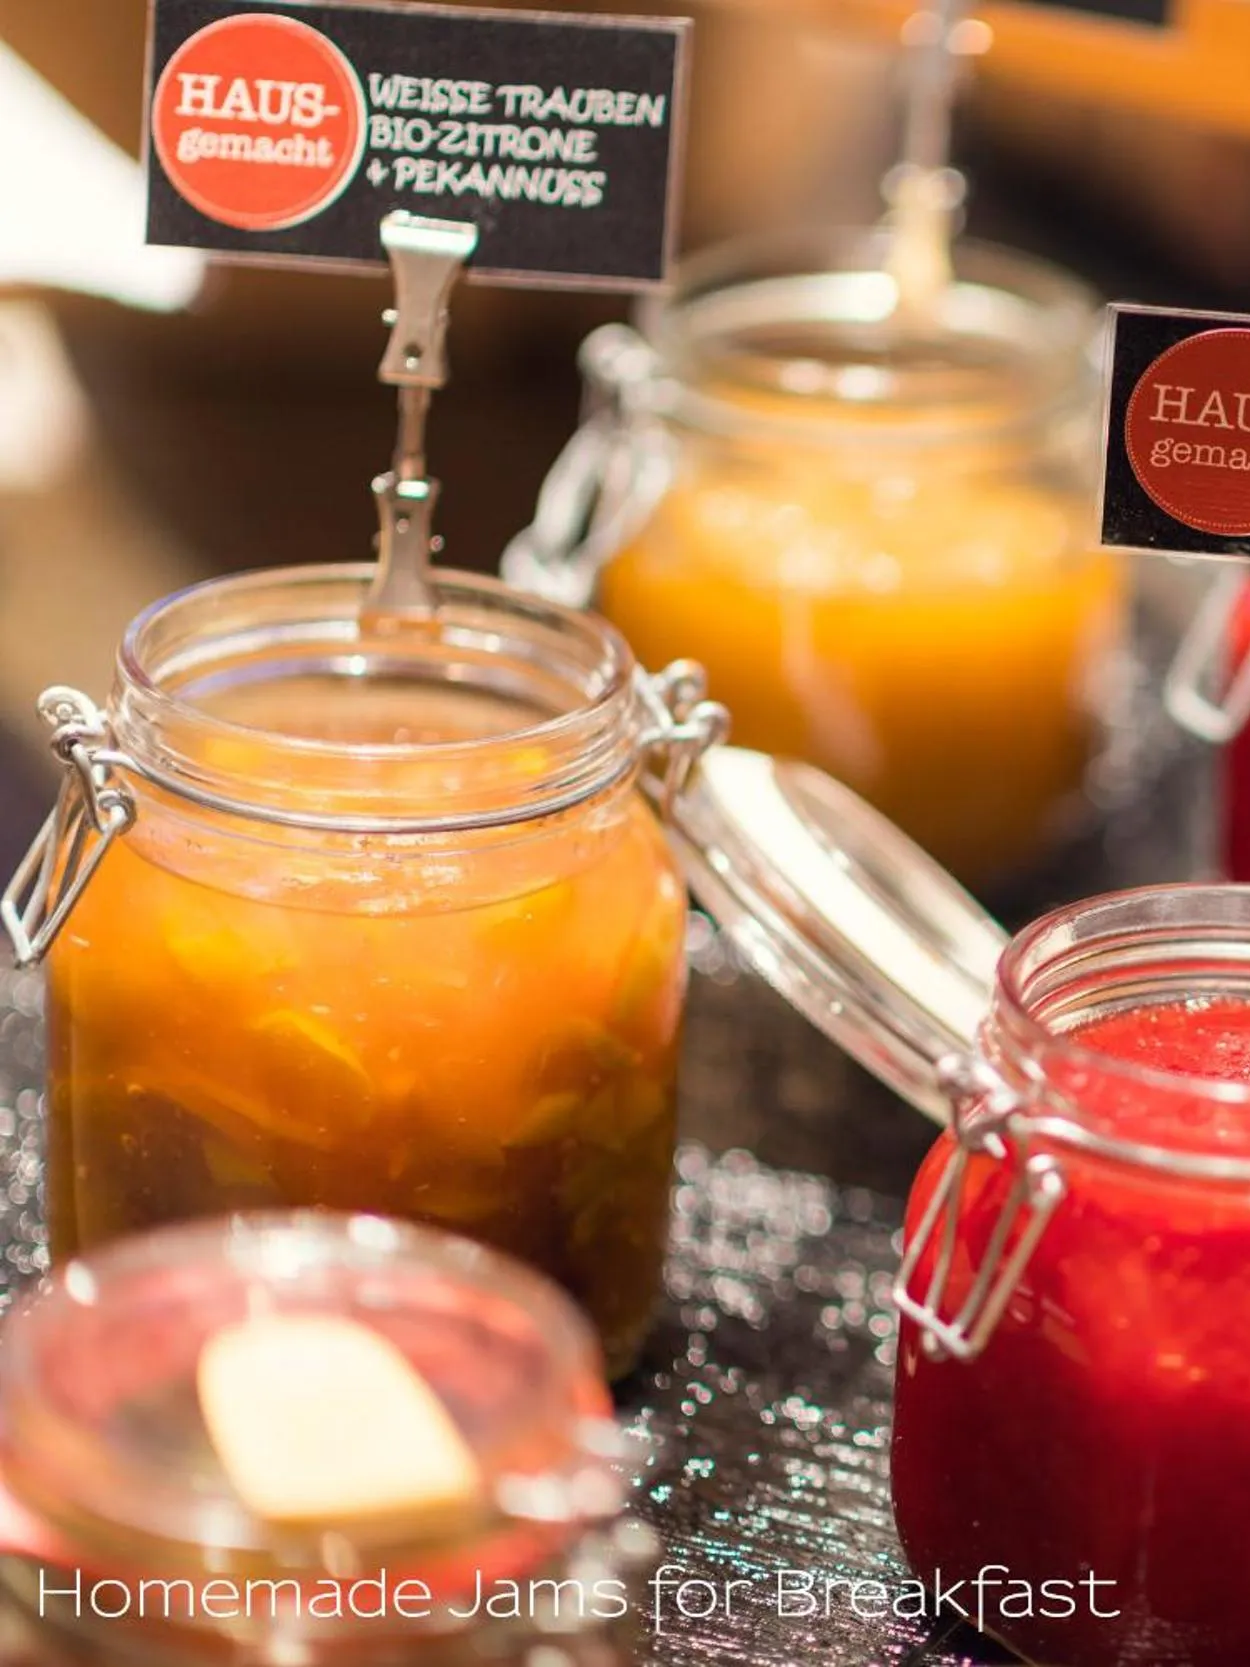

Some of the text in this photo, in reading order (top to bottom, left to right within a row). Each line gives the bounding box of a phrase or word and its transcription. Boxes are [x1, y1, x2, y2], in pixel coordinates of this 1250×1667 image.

[175, 73, 339, 127] HAUS-
[368, 73, 665, 128] WEISSE TRAUBEN
[177, 128, 334, 167] gemacht
[368, 115, 598, 164] BIO-ZITRONE
[393, 157, 607, 207] PEKANNUSS
